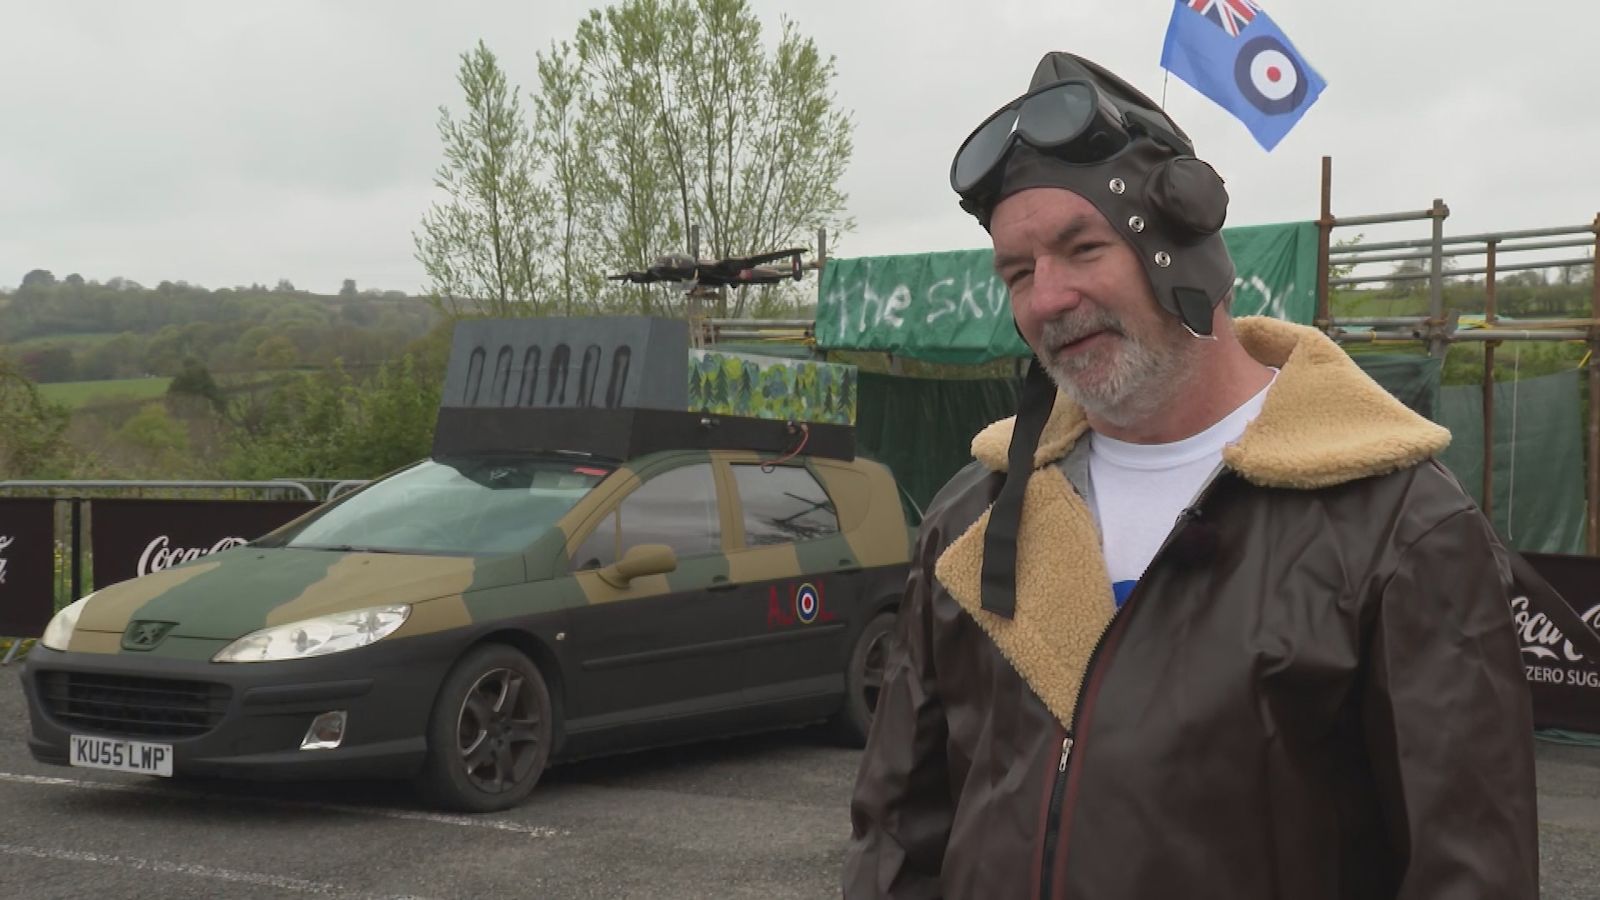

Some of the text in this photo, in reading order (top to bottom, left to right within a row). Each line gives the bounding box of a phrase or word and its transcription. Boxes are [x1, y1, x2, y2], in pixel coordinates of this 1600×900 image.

[137, 535, 249, 578] Coca-
[1526, 665, 1600, 688] ZERO SUG
[77, 739, 165, 770] KU55 LWP
